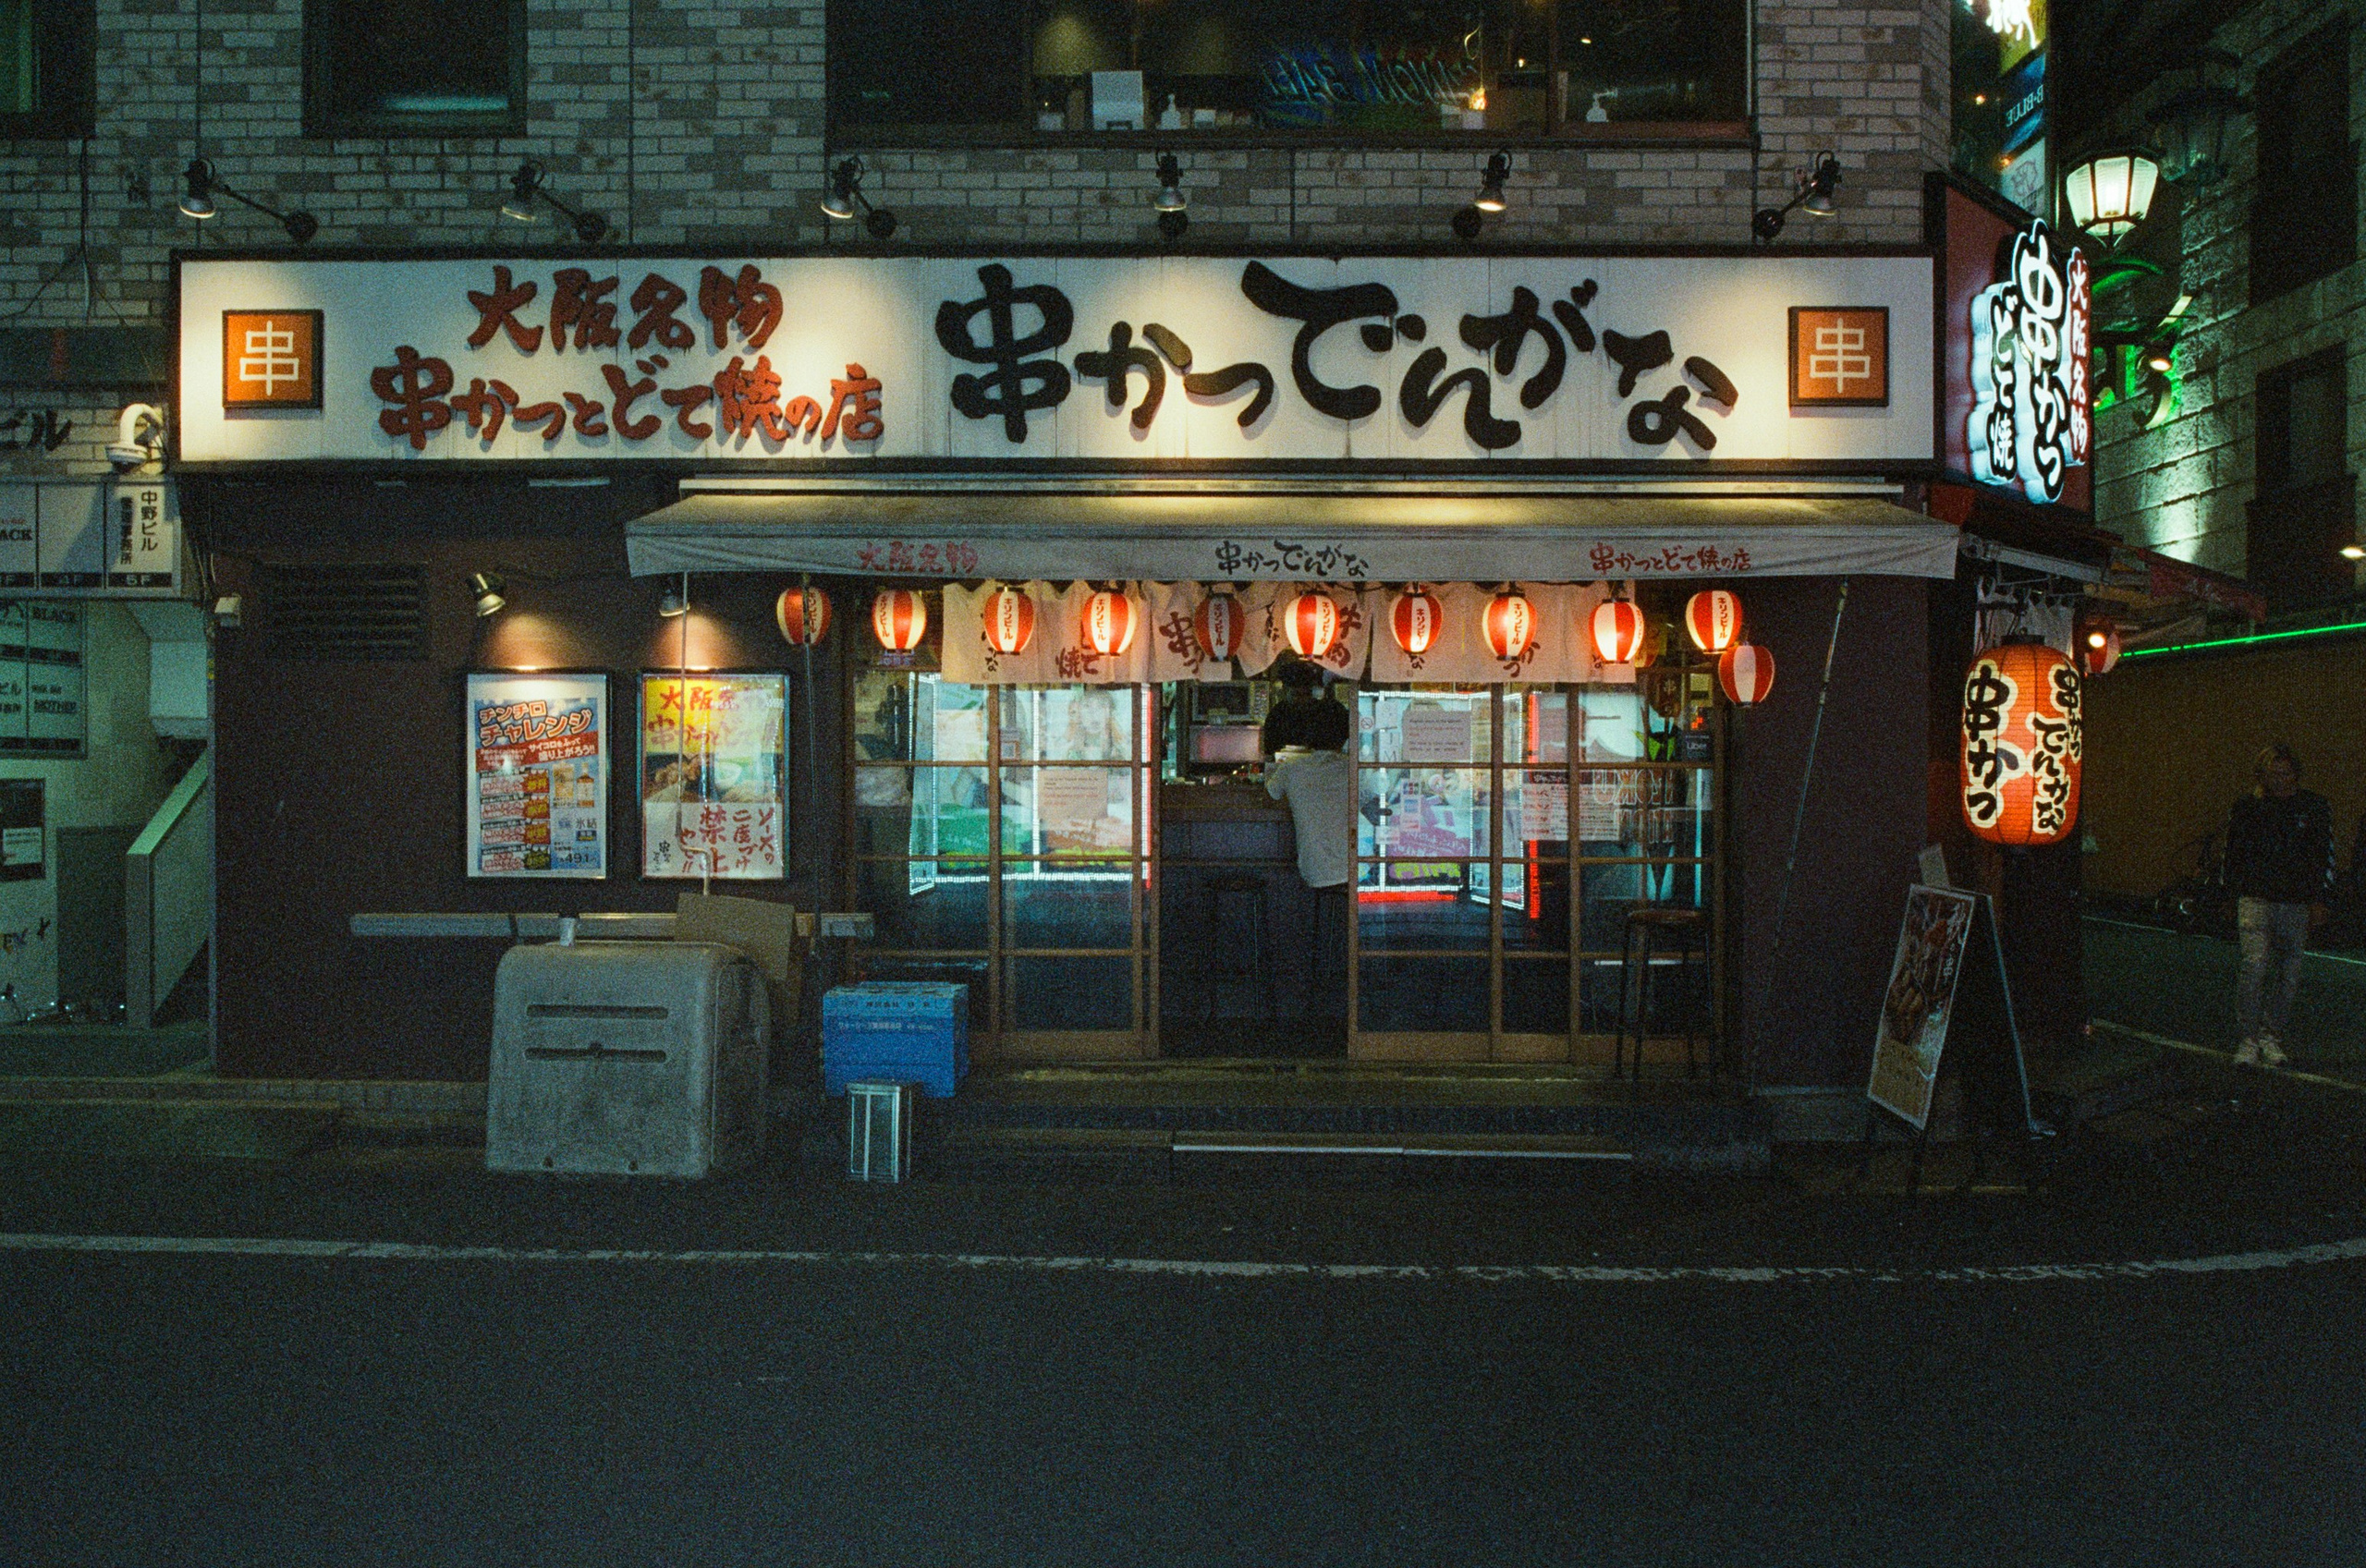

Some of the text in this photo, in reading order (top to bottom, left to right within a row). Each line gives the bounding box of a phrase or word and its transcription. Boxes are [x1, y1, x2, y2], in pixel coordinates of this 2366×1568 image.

[467, 264, 784, 352] 大阪名物
[238, 320, 299, 396] 串
[934, 259, 1739, 451] 串かつでんがな
[1809, 317, 1871, 395] 串
[1990, 293, 2018, 471] どて焼
[2019, 234, 2067, 487] 串かつ
[2071, 259, 2088, 456] 大阪名物
[370, 345, 884, 451] 串かつとどて焼の店
[856, 540, 979, 575] 大阪名物
[1214, 538, 1370, 577] 串かつでんがな
[1003, 597, 1014, 640] キリンビール
[1094, 598, 1107, 642] キリンビール
[1511, 602, 1523, 646] キリンビール
[1717, 597, 1728, 639] キリンビール
[479, 699, 548, 725] チンチロ
[479, 708, 593, 748] チャレンジ
[1965, 663, 2020, 820] 串かつ
